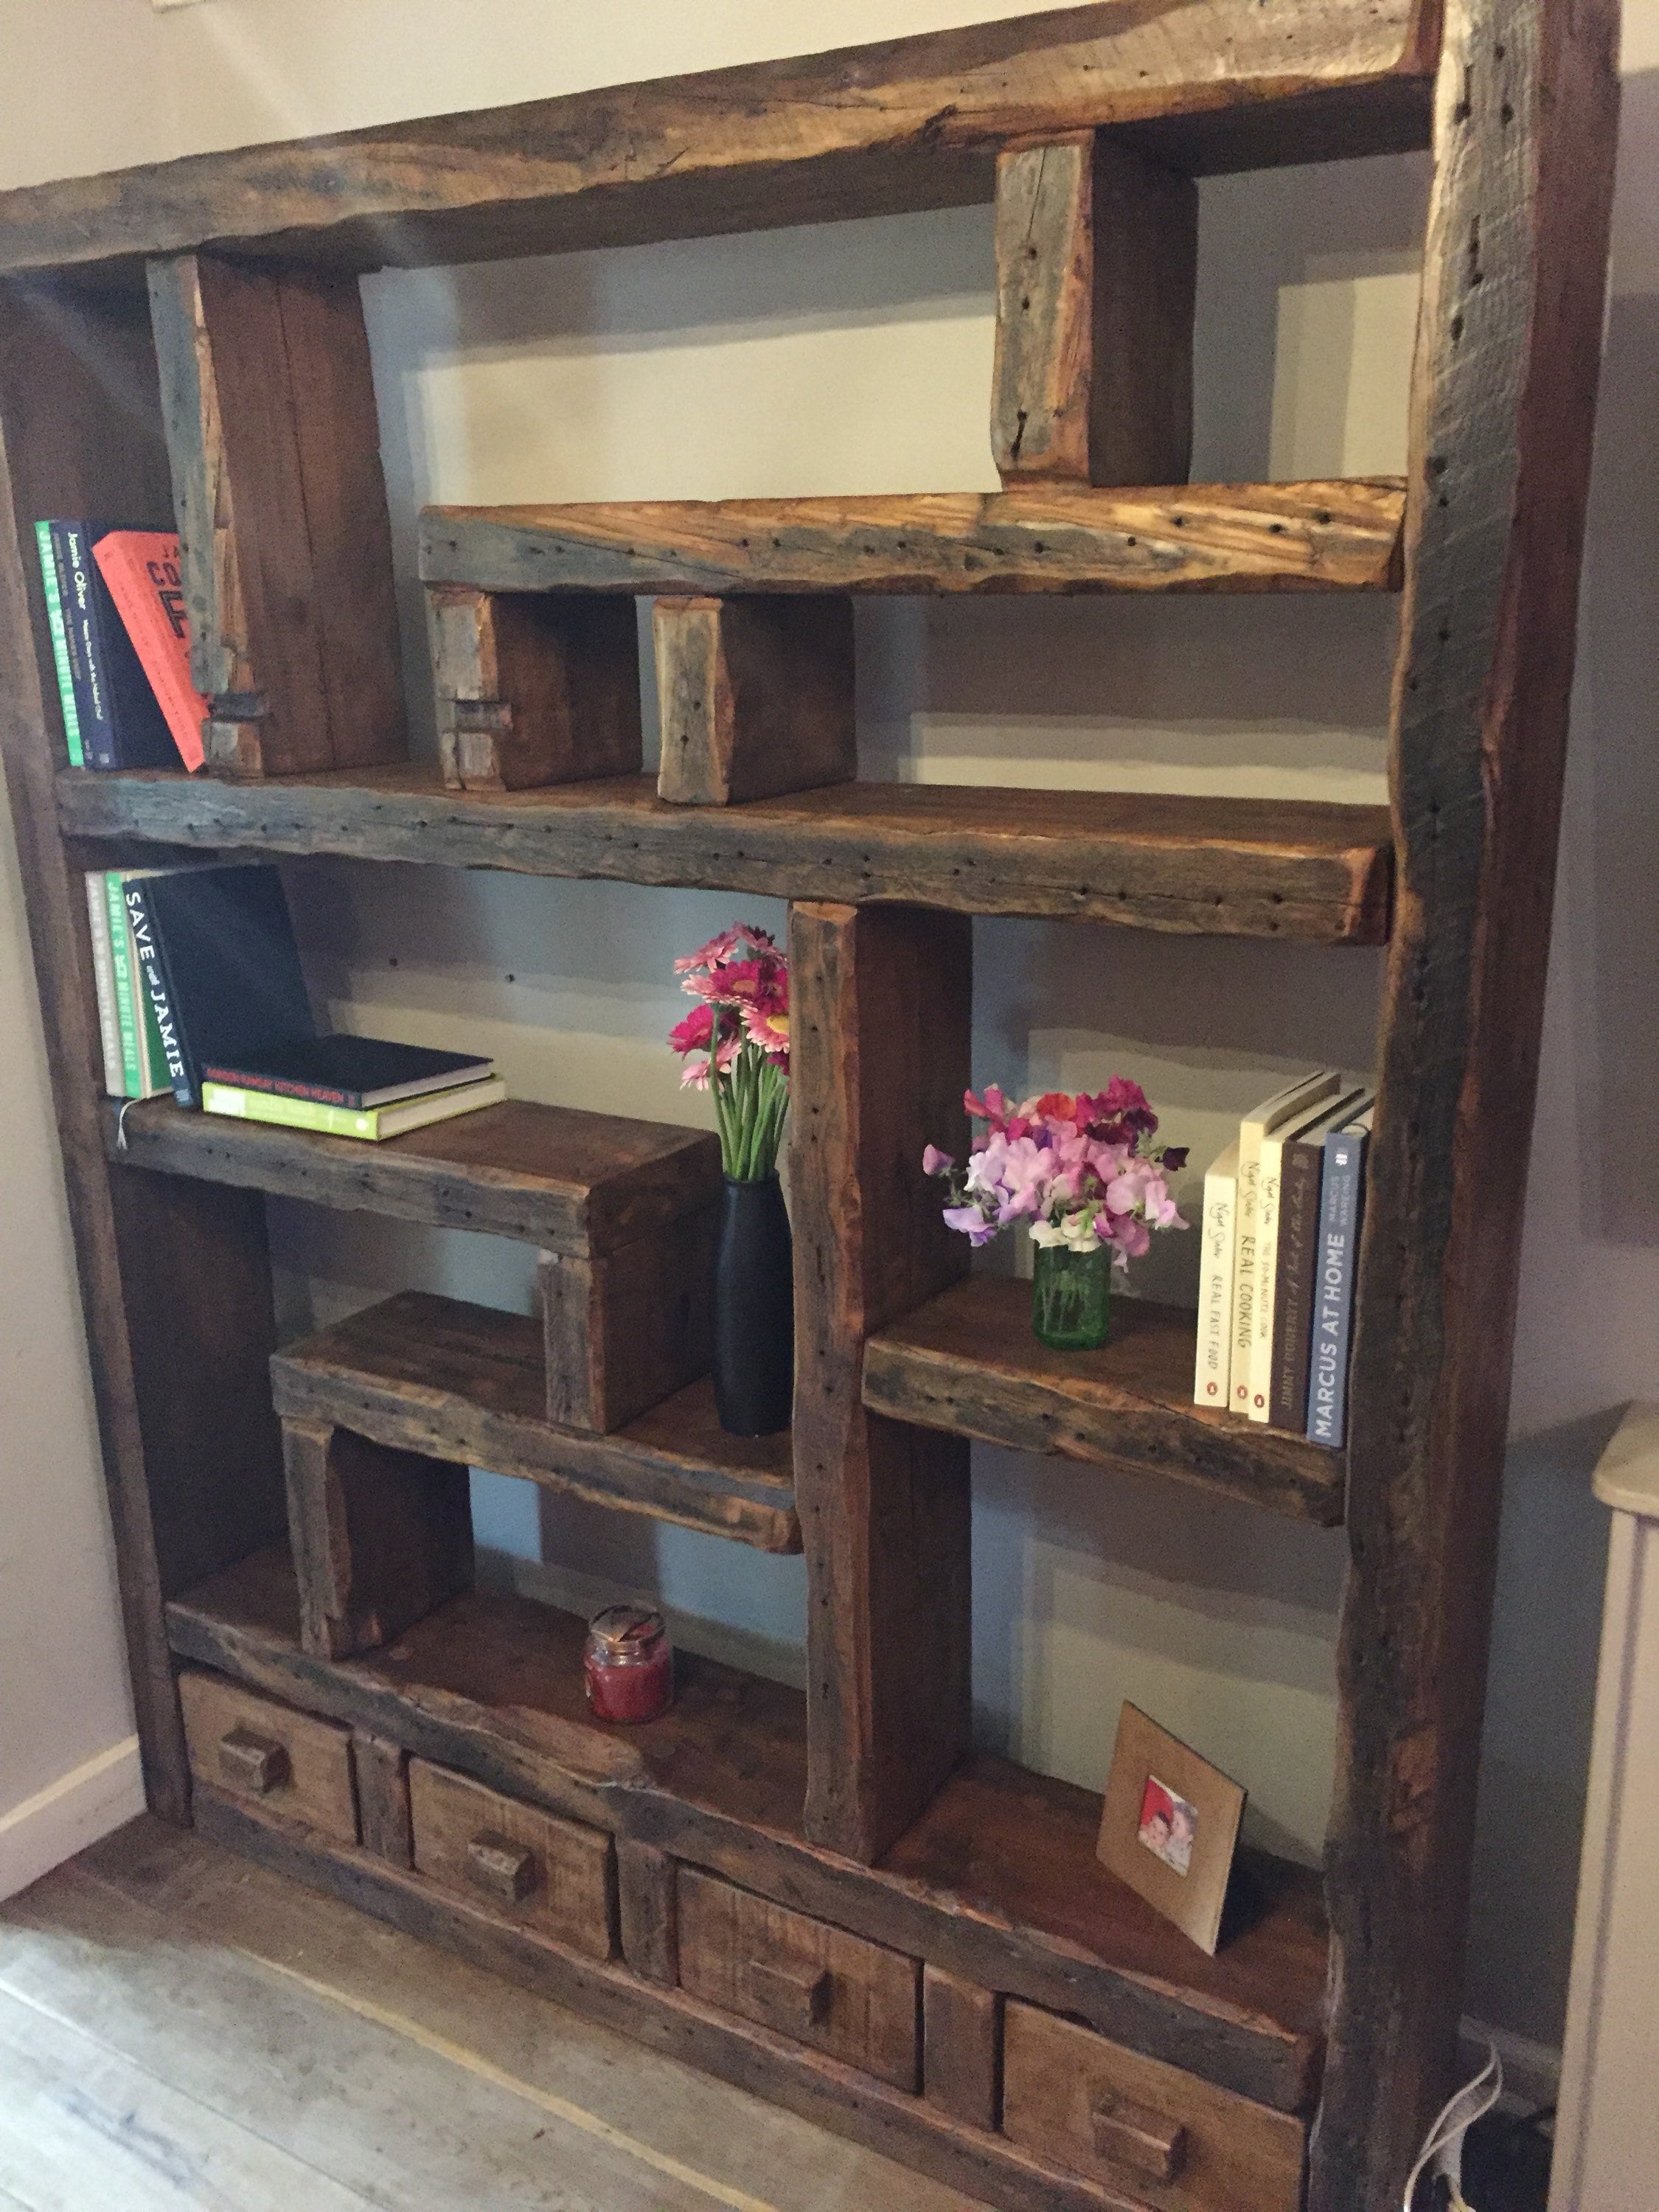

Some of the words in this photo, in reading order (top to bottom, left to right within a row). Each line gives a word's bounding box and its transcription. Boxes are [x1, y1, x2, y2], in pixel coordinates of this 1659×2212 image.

[68, 532, 82, 568] Jamie
[74, 571, 87, 611] Oliver
[108, 882, 125, 948] JAMIE'S
[122, 1030, 136, 1071] MEALS
[126, 891, 156, 961] SAVE
[150, 990, 184, 1078] JAMIE
[1329, 1175, 1340, 1222] MARCUS
[1239, 1235, 1256, 1275] REAL
[1324, 1234, 1345, 1301] HOME
[1211, 1274, 1223, 1304] REAL
[1209, 1310, 1221, 1337] FAST
[1238, 1283, 1254, 1349] COOKING
[1321, 1305, 1340, 1337] AT
[1208, 1341, 1220, 1369] FOOD
[1315, 1342, 1338, 1438] MARCUS
